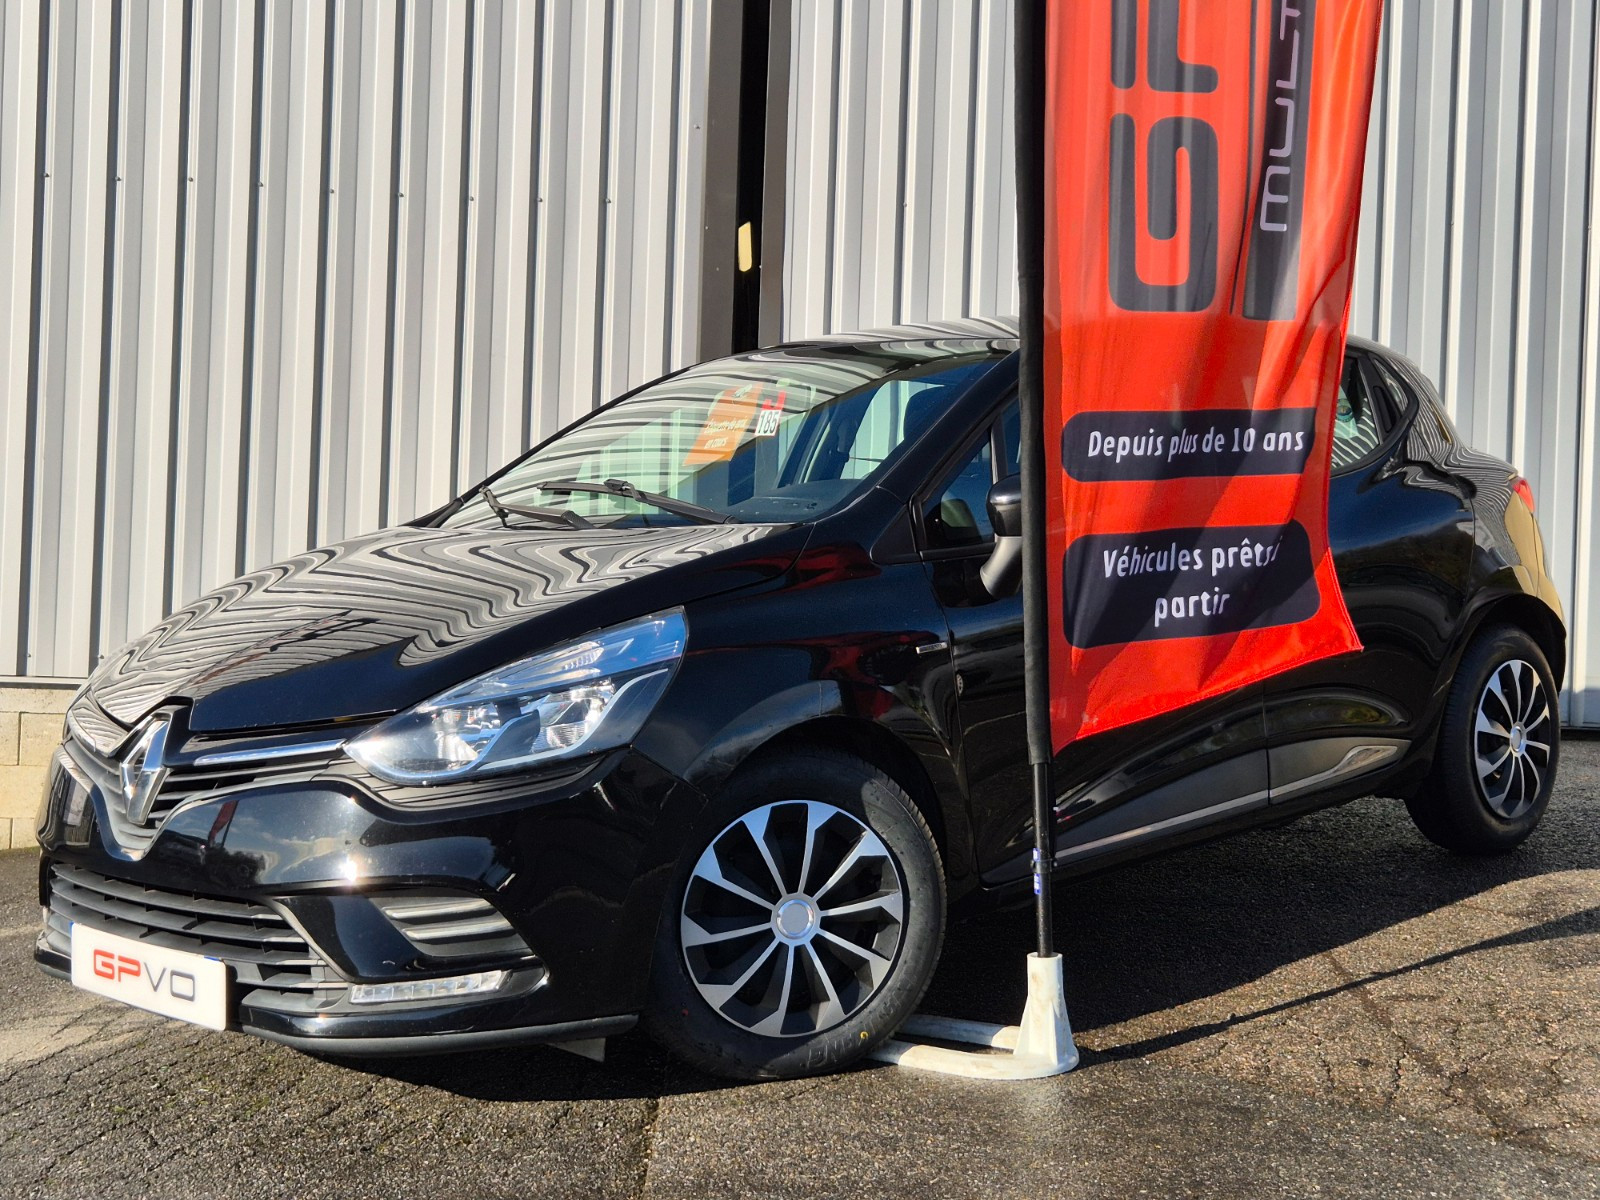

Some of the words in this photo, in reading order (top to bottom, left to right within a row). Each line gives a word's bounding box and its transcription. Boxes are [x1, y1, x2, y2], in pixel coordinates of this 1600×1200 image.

[757, 411, 780, 434] 185
[1087, 428, 1165, 463] Depuis
[1168, 427, 1198, 463] plus
[1201, 426, 1225, 454] de
[1231, 427, 1255, 453] 10
[1262, 429, 1305, 452] ans
[1103, 542, 1203, 578] Véhicules
[1153, 586, 1231, 627] partir
[93, 948, 196, 1003] GPVO
